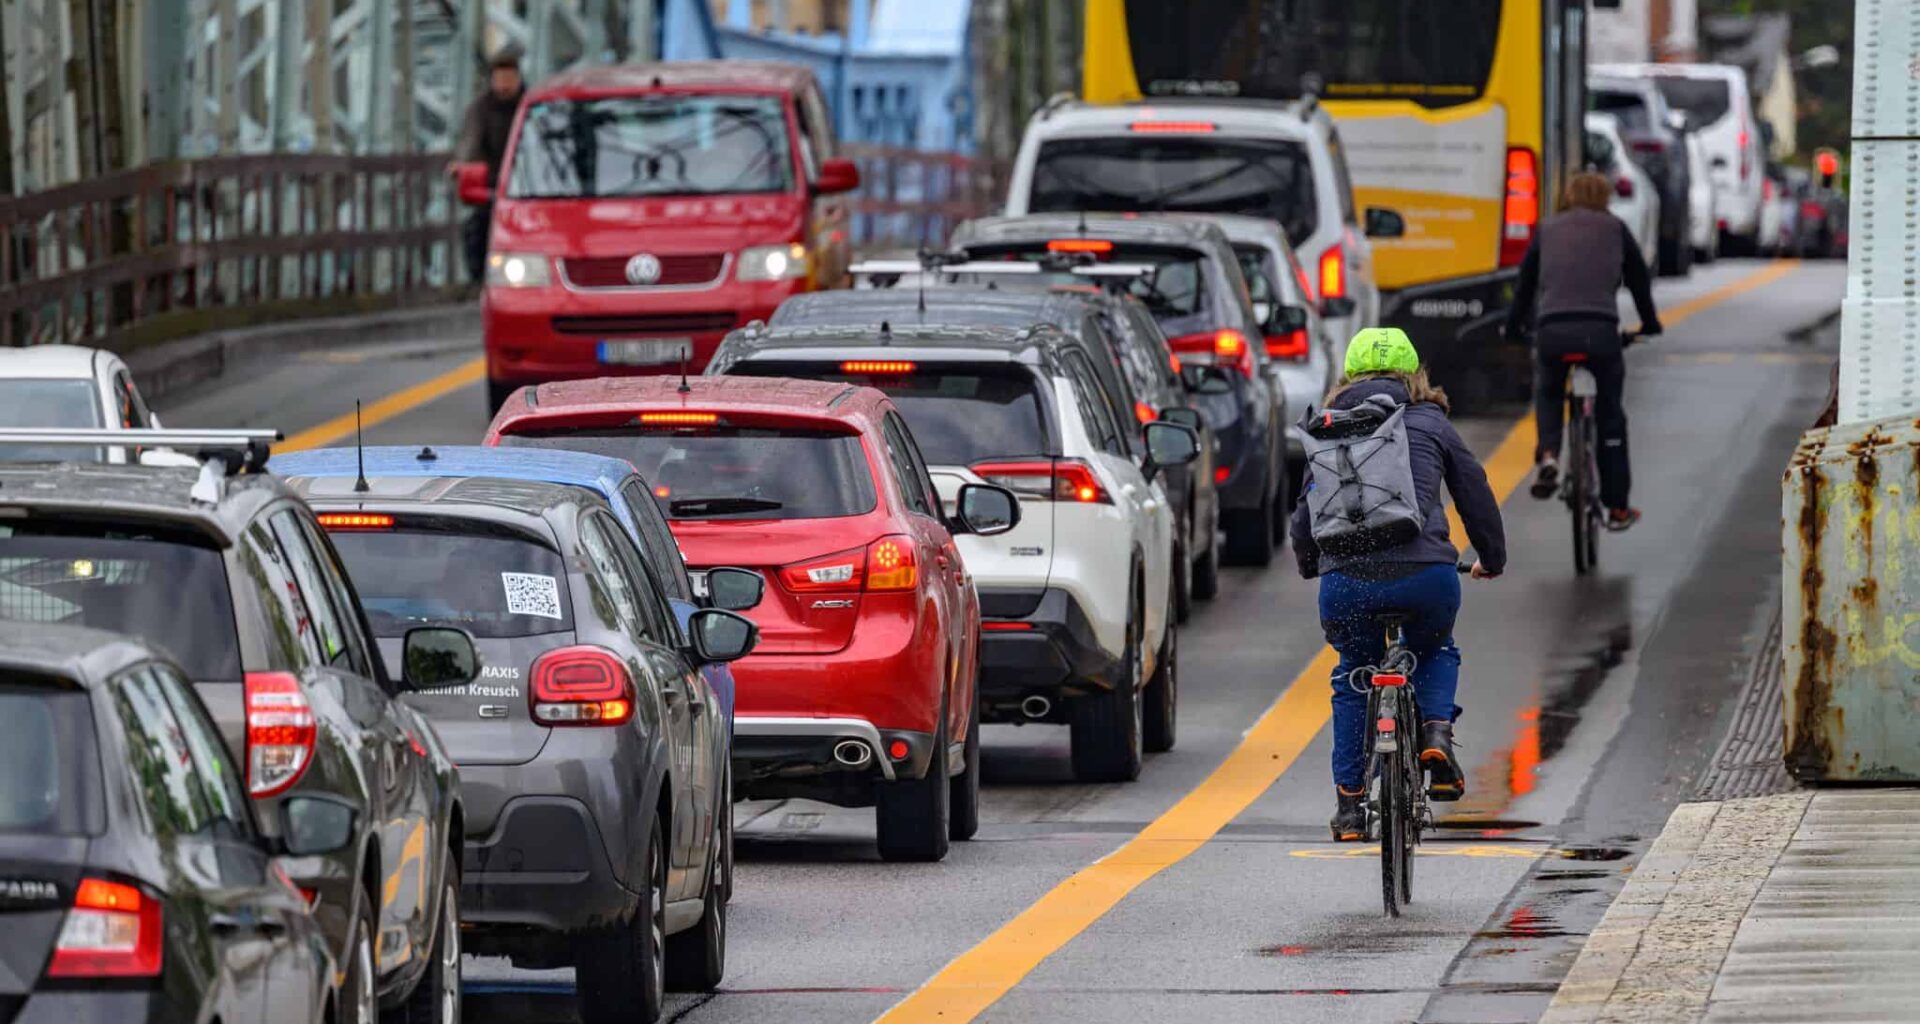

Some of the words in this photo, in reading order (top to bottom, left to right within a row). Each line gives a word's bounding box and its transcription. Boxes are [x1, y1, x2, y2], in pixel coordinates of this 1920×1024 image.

[810, 600, 854, 609] ASX
[481, 666, 519, 679] RAXIS
[469, 683, 519, 697] Kreusch
